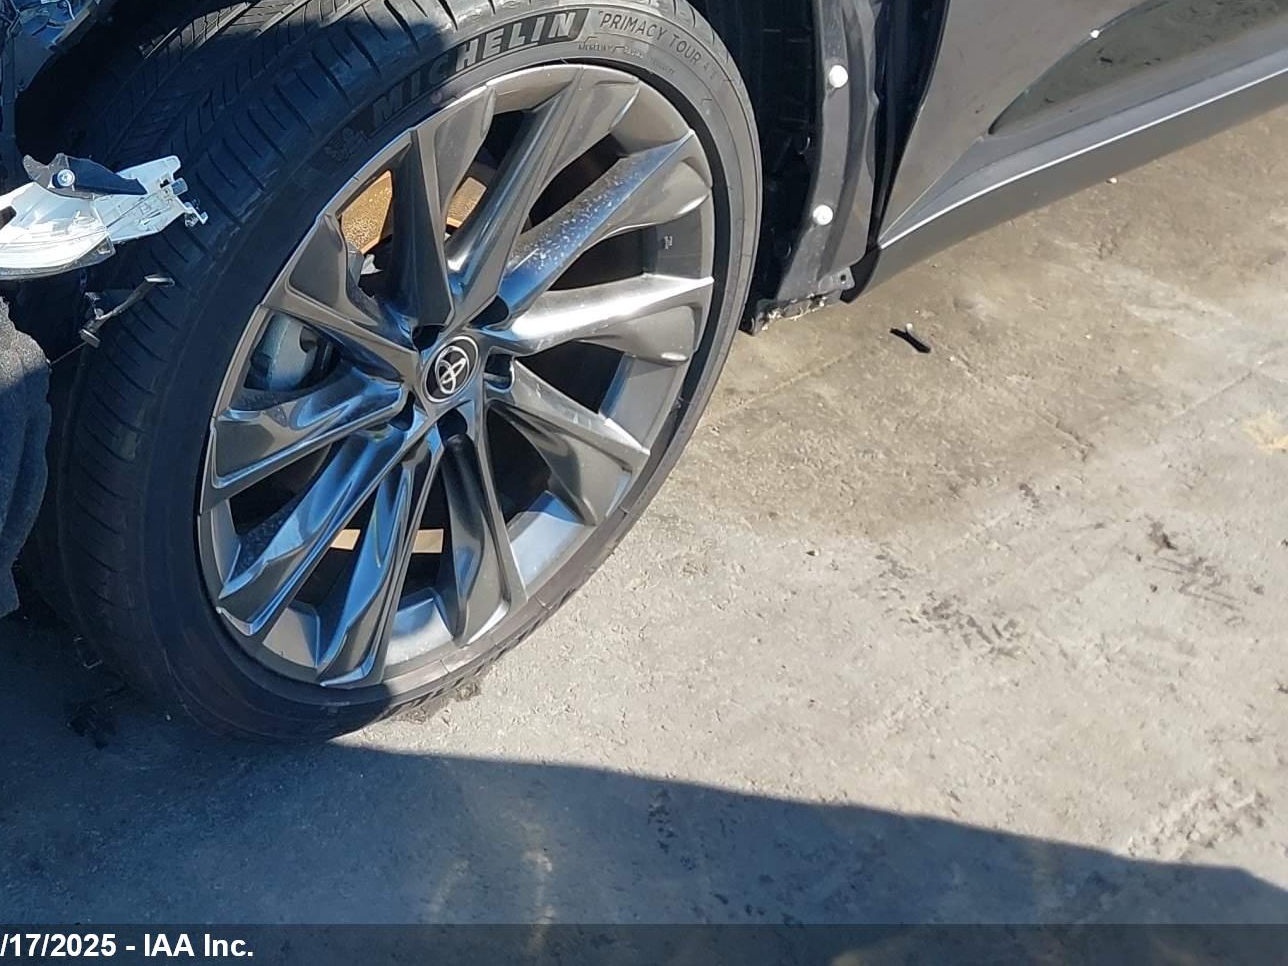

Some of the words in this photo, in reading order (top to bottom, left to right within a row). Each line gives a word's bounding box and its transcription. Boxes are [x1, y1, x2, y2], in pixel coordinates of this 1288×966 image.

[372, 12, 576, 129] MICHELIN
[600, 12, 668, 38] PRIMACY
[669, 34, 702, 65] TOUR
